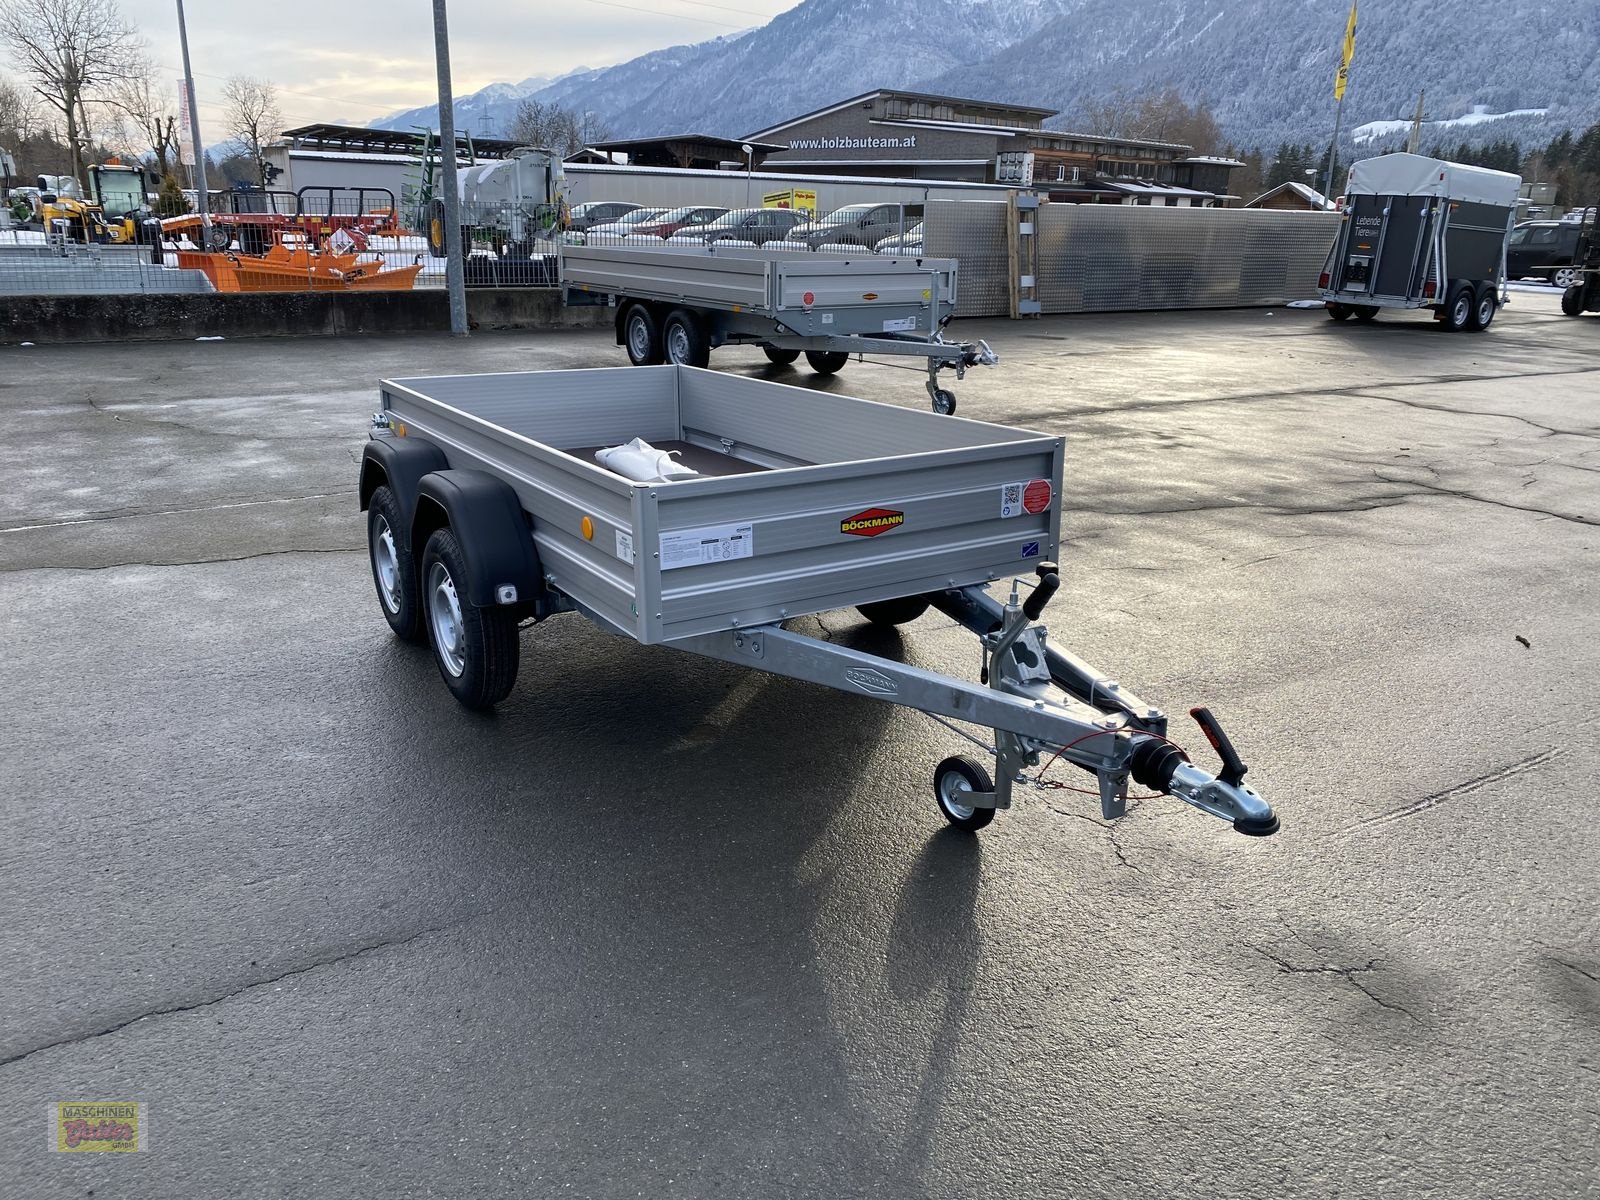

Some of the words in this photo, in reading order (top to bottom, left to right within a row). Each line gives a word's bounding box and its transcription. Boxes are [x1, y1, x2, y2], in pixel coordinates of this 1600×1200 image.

[789, 135, 916, 149] www.holzbauteam.at
[1356, 215, 1381, 226] Lebende
[1355, 226, 1370, 237] Tiere
[841, 515, 903, 532] BÖCKMANN
